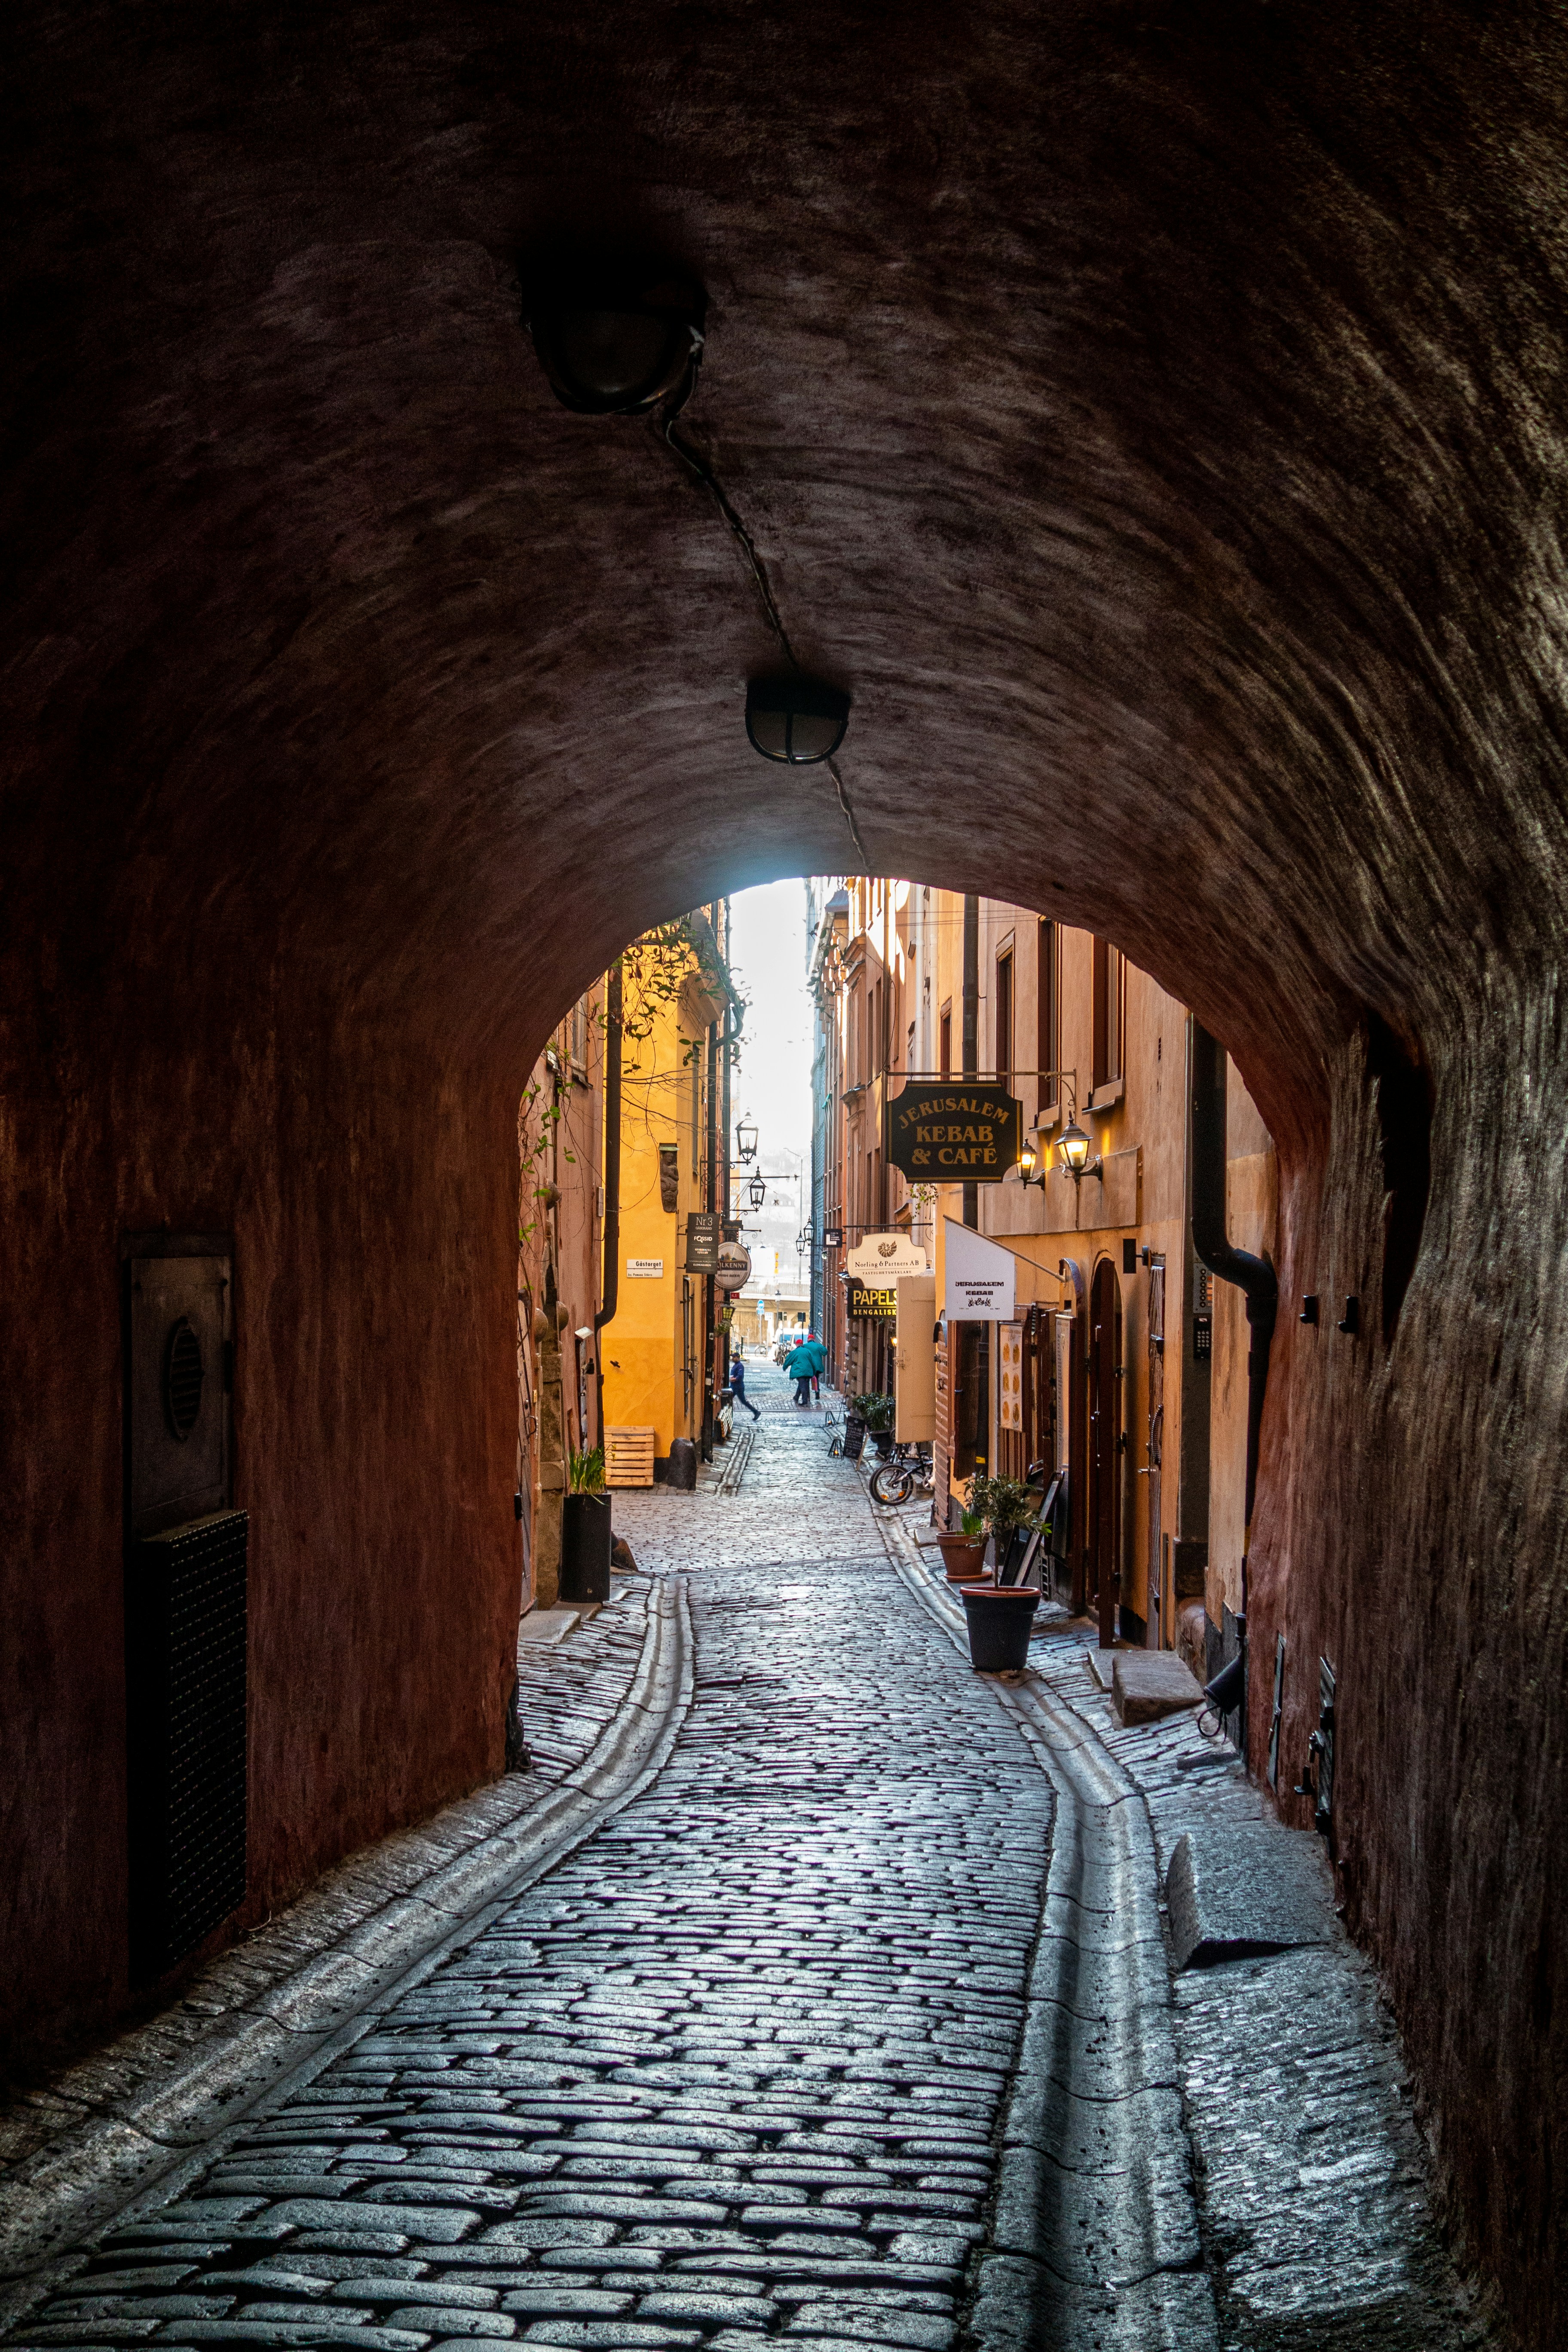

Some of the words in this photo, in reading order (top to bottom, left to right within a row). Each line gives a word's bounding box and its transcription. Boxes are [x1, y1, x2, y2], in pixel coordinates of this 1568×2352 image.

[898, 1098, 1010, 1129] JERUSALEM
[916, 1126, 993, 1142] KEBAB
[912, 1148, 931, 1164] &
[938, 1142, 998, 1164] CAFÉ
[696, 1217, 706, 1225] Nr
[707, 1217, 713, 1225] 3
